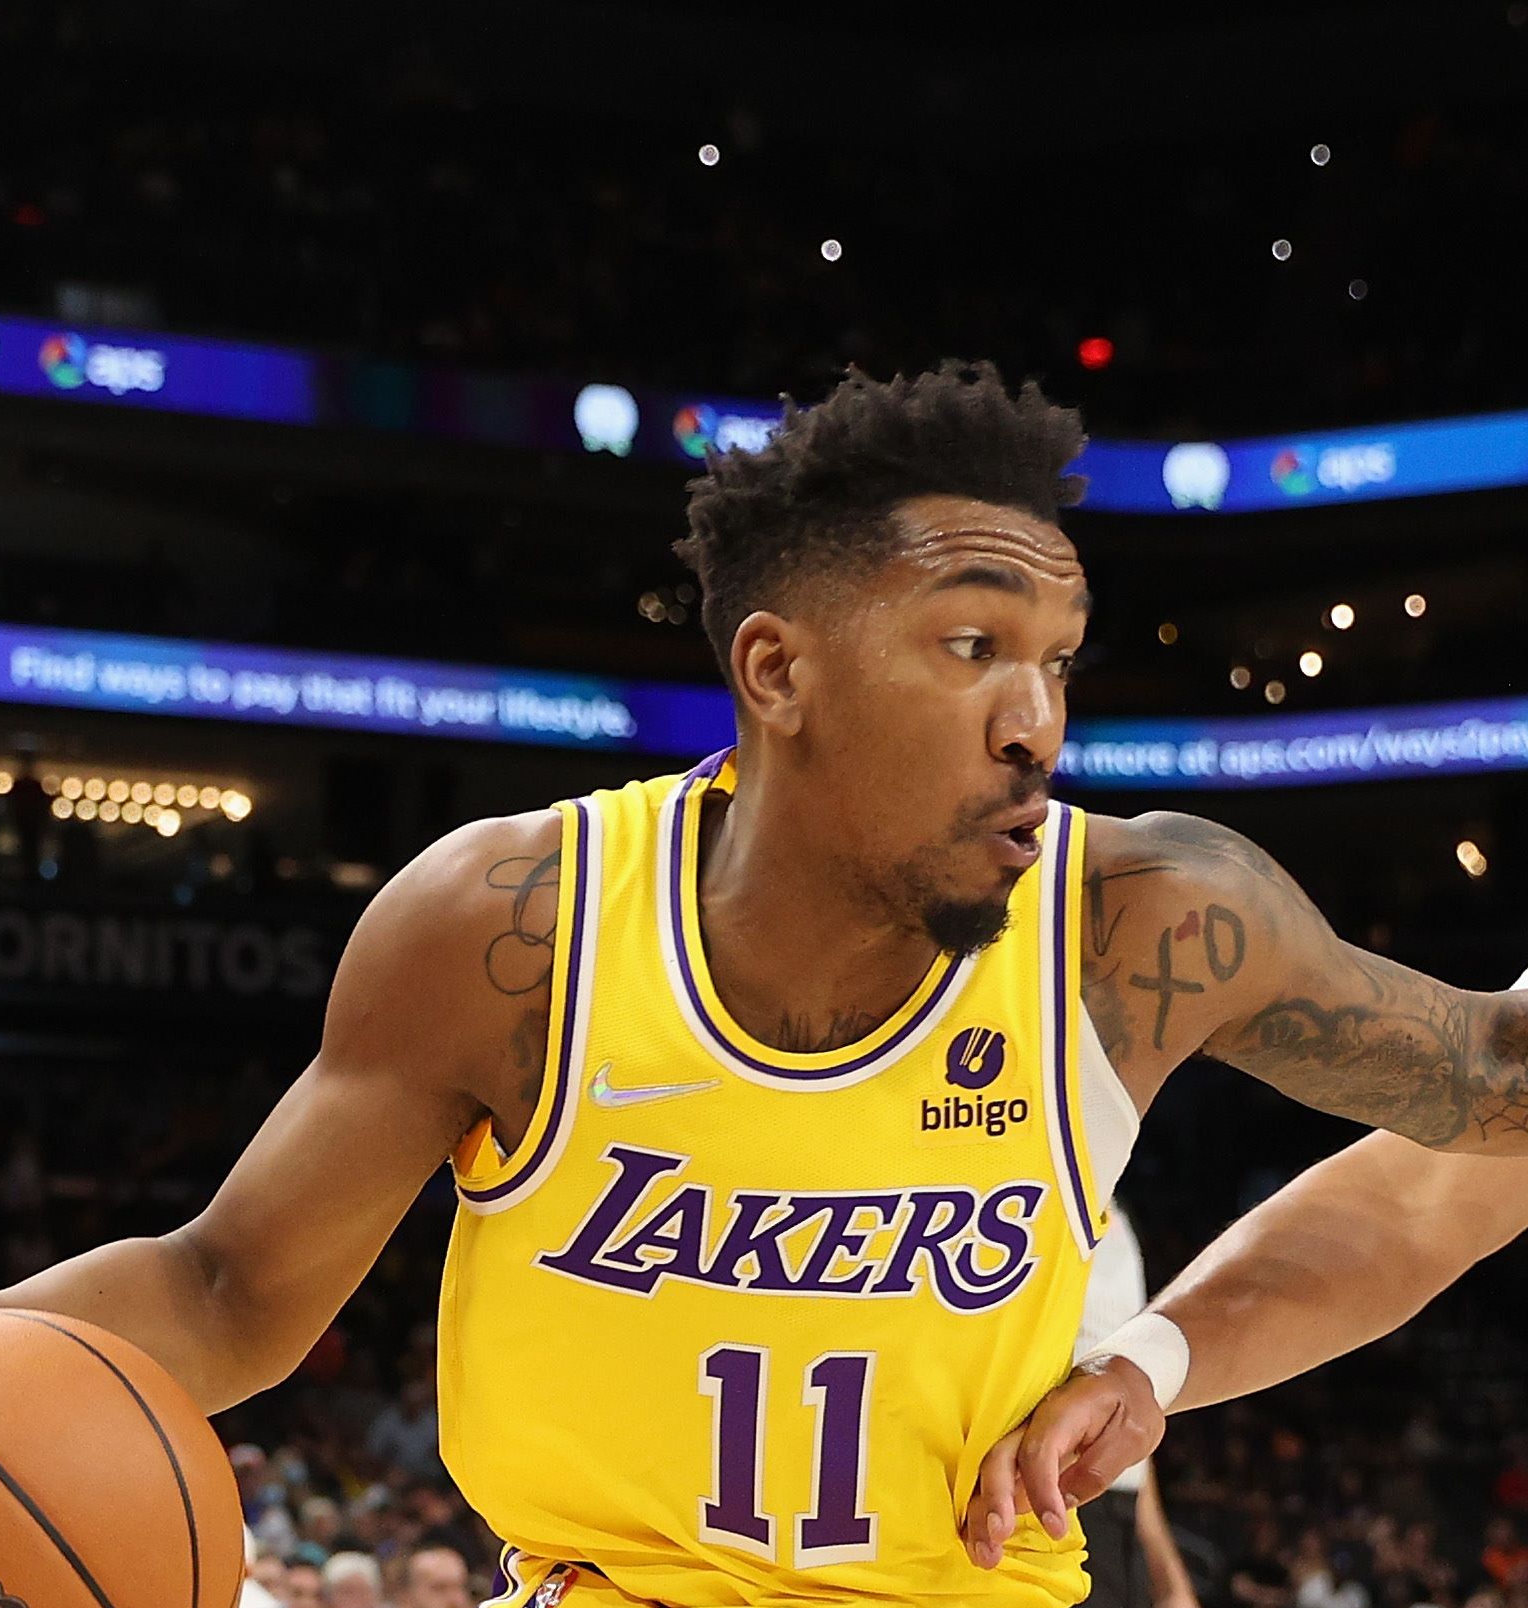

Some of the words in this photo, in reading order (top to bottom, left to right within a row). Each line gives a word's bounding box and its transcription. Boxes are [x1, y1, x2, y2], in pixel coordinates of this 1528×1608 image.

[87, 344, 166, 395] aps
[10, 645, 97, 693] Find
[97, 661, 187, 704] ways
[187, 662, 231, 704] to
[231, 669, 299, 715] pay
[301, 672, 373, 716] that
[374, 675, 419, 720] fit
[420, 688, 496, 727] your
[921, 1095, 1028, 1137] bibigo
[531, 1141, 1050, 1315] LAKERS
[697, 1341, 880, 1570] 11
